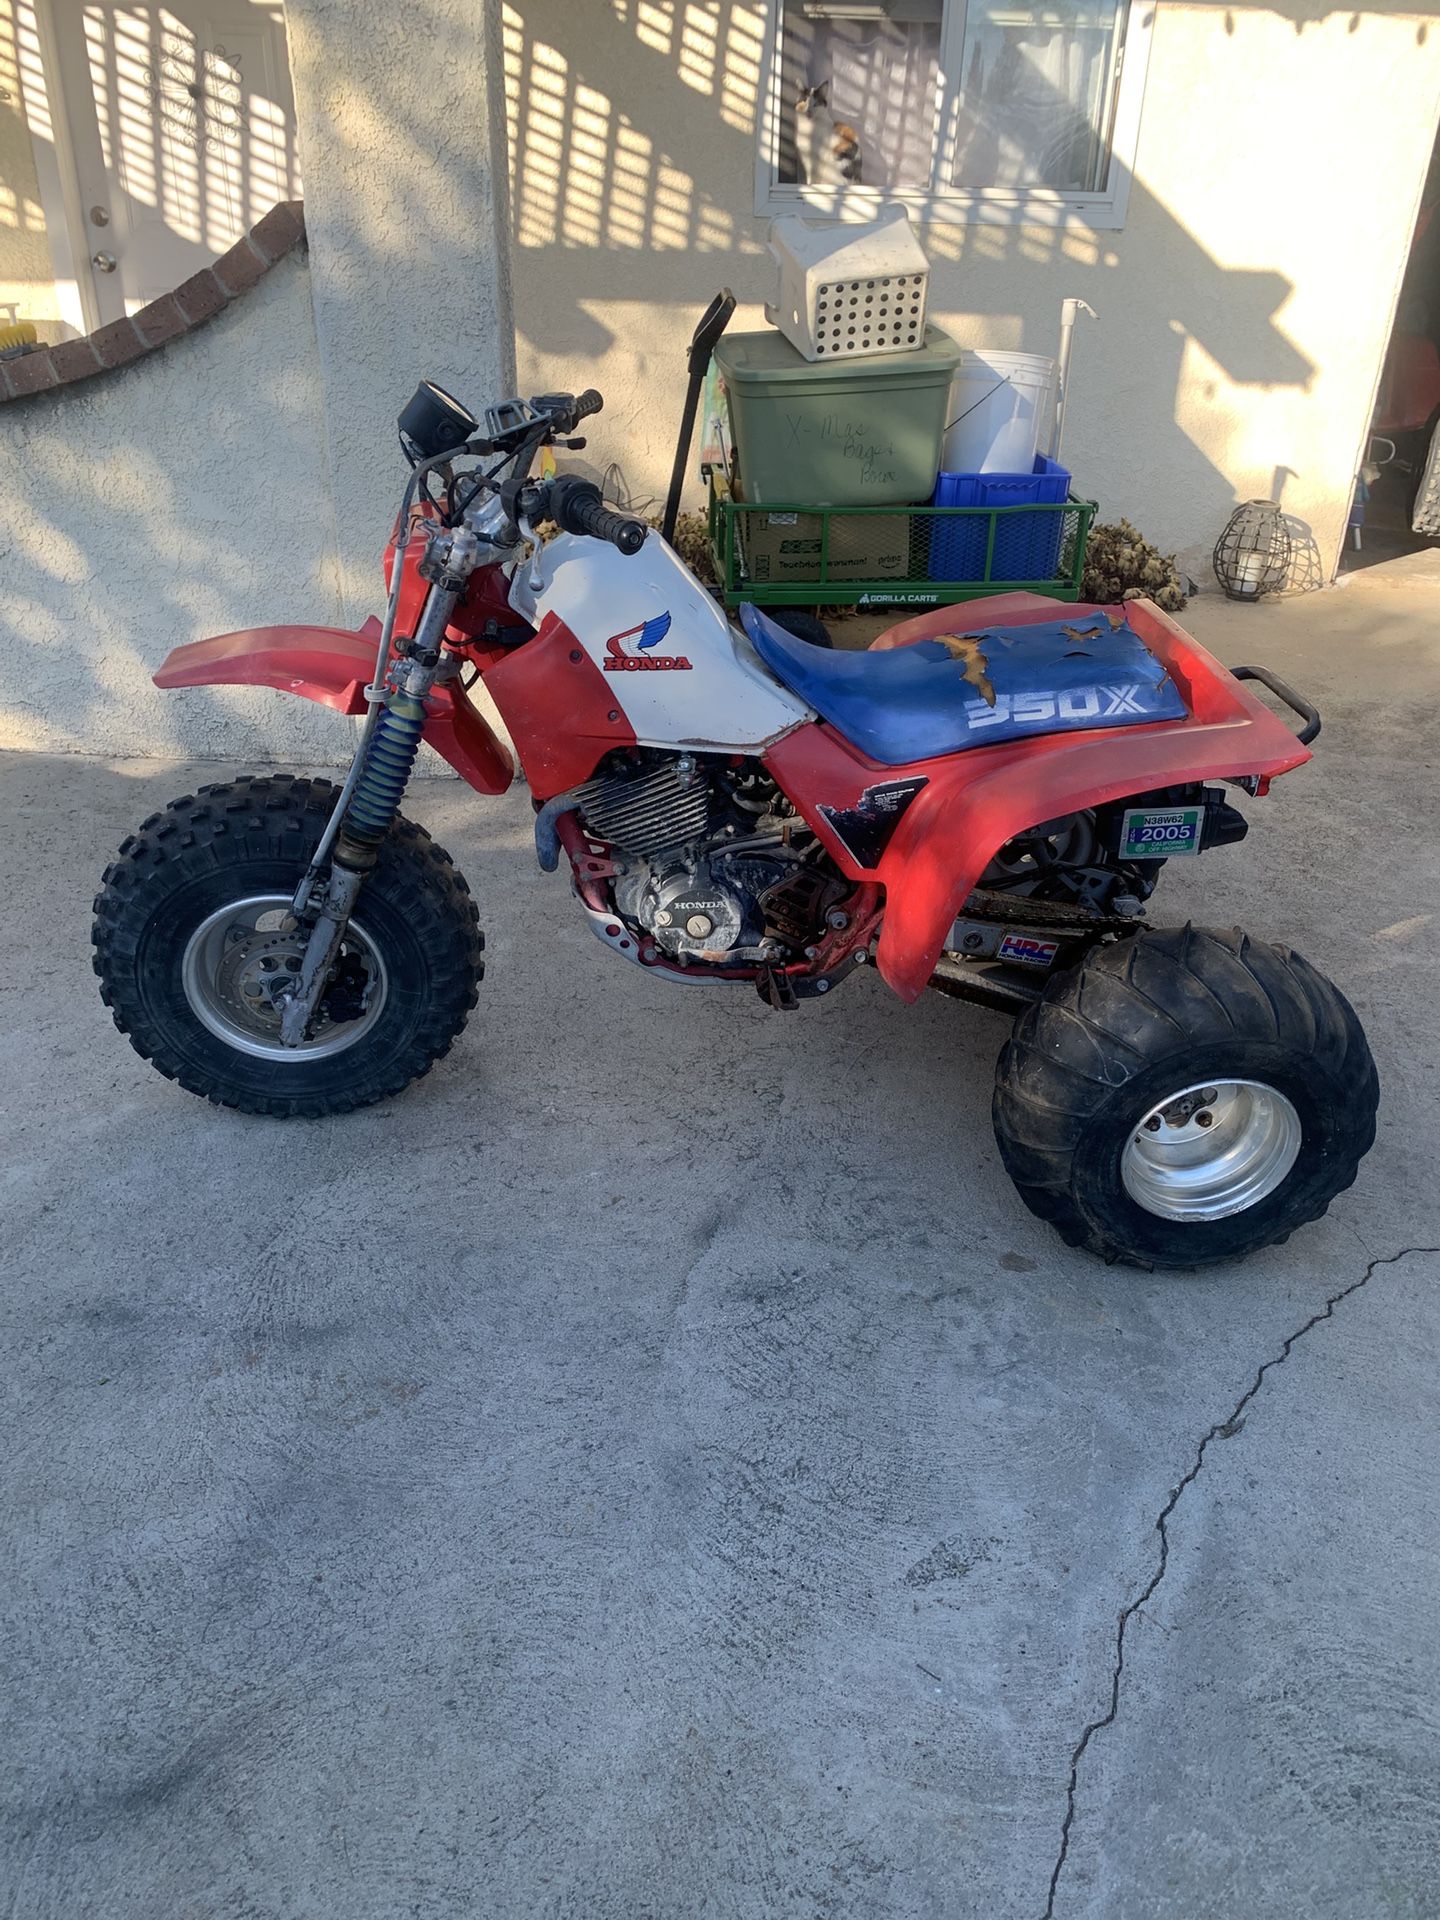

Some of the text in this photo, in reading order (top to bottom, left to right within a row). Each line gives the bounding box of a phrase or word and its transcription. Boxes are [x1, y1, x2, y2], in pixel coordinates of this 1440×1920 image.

[870, 594, 937, 602] GORILLA CARTS
[603, 656, 693, 671] HONDA
[963, 685, 1149, 729] 350X
[1144, 815, 1184, 825] N38W62
[1141, 825, 1191, 842] 2005
[1151, 839, 1186, 847] CALIFORNIA
[674, 901, 727, 909] HONDA
[1001, 937, 1057, 960] HRC
[999, 953, 1051, 965] HONDA RACING
